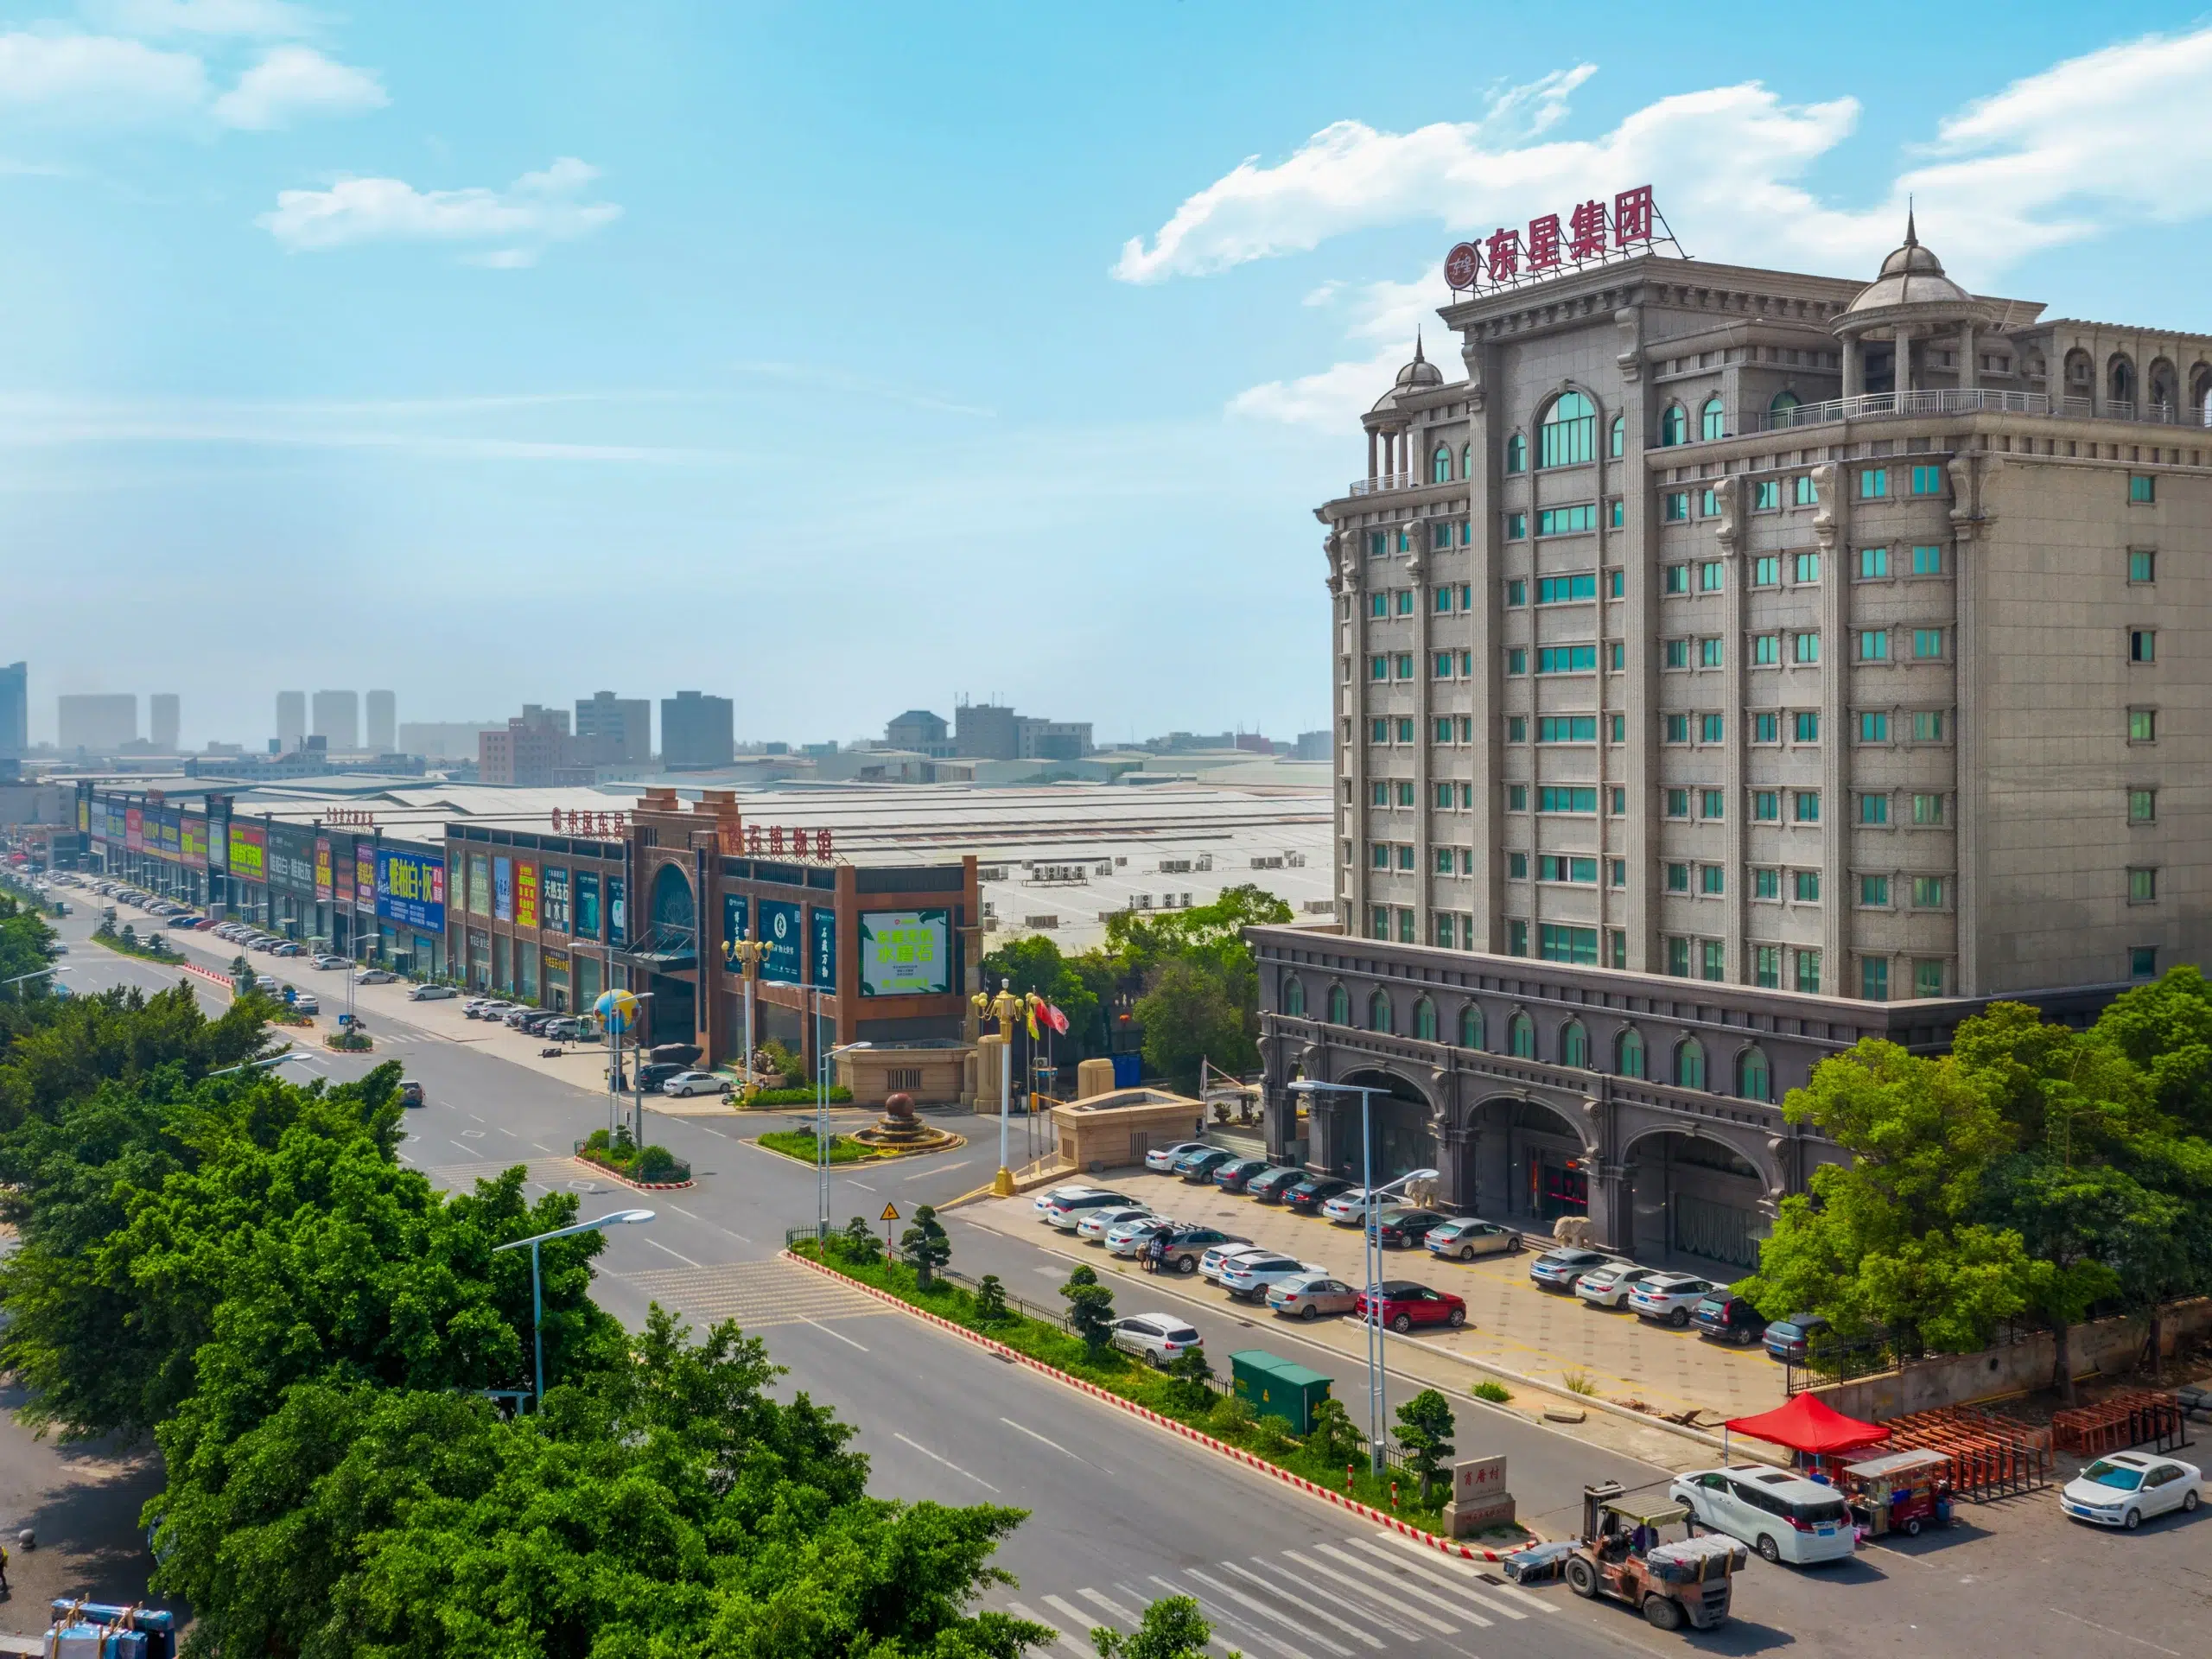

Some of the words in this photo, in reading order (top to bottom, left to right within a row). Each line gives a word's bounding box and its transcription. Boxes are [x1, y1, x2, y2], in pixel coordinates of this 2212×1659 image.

[1485, 185, 1652, 281] 东星集团
[569, 809, 624, 837] 中国东星
[544, 880, 569, 901] 天然玉石
[876, 944, 934, 963] 水磨石
